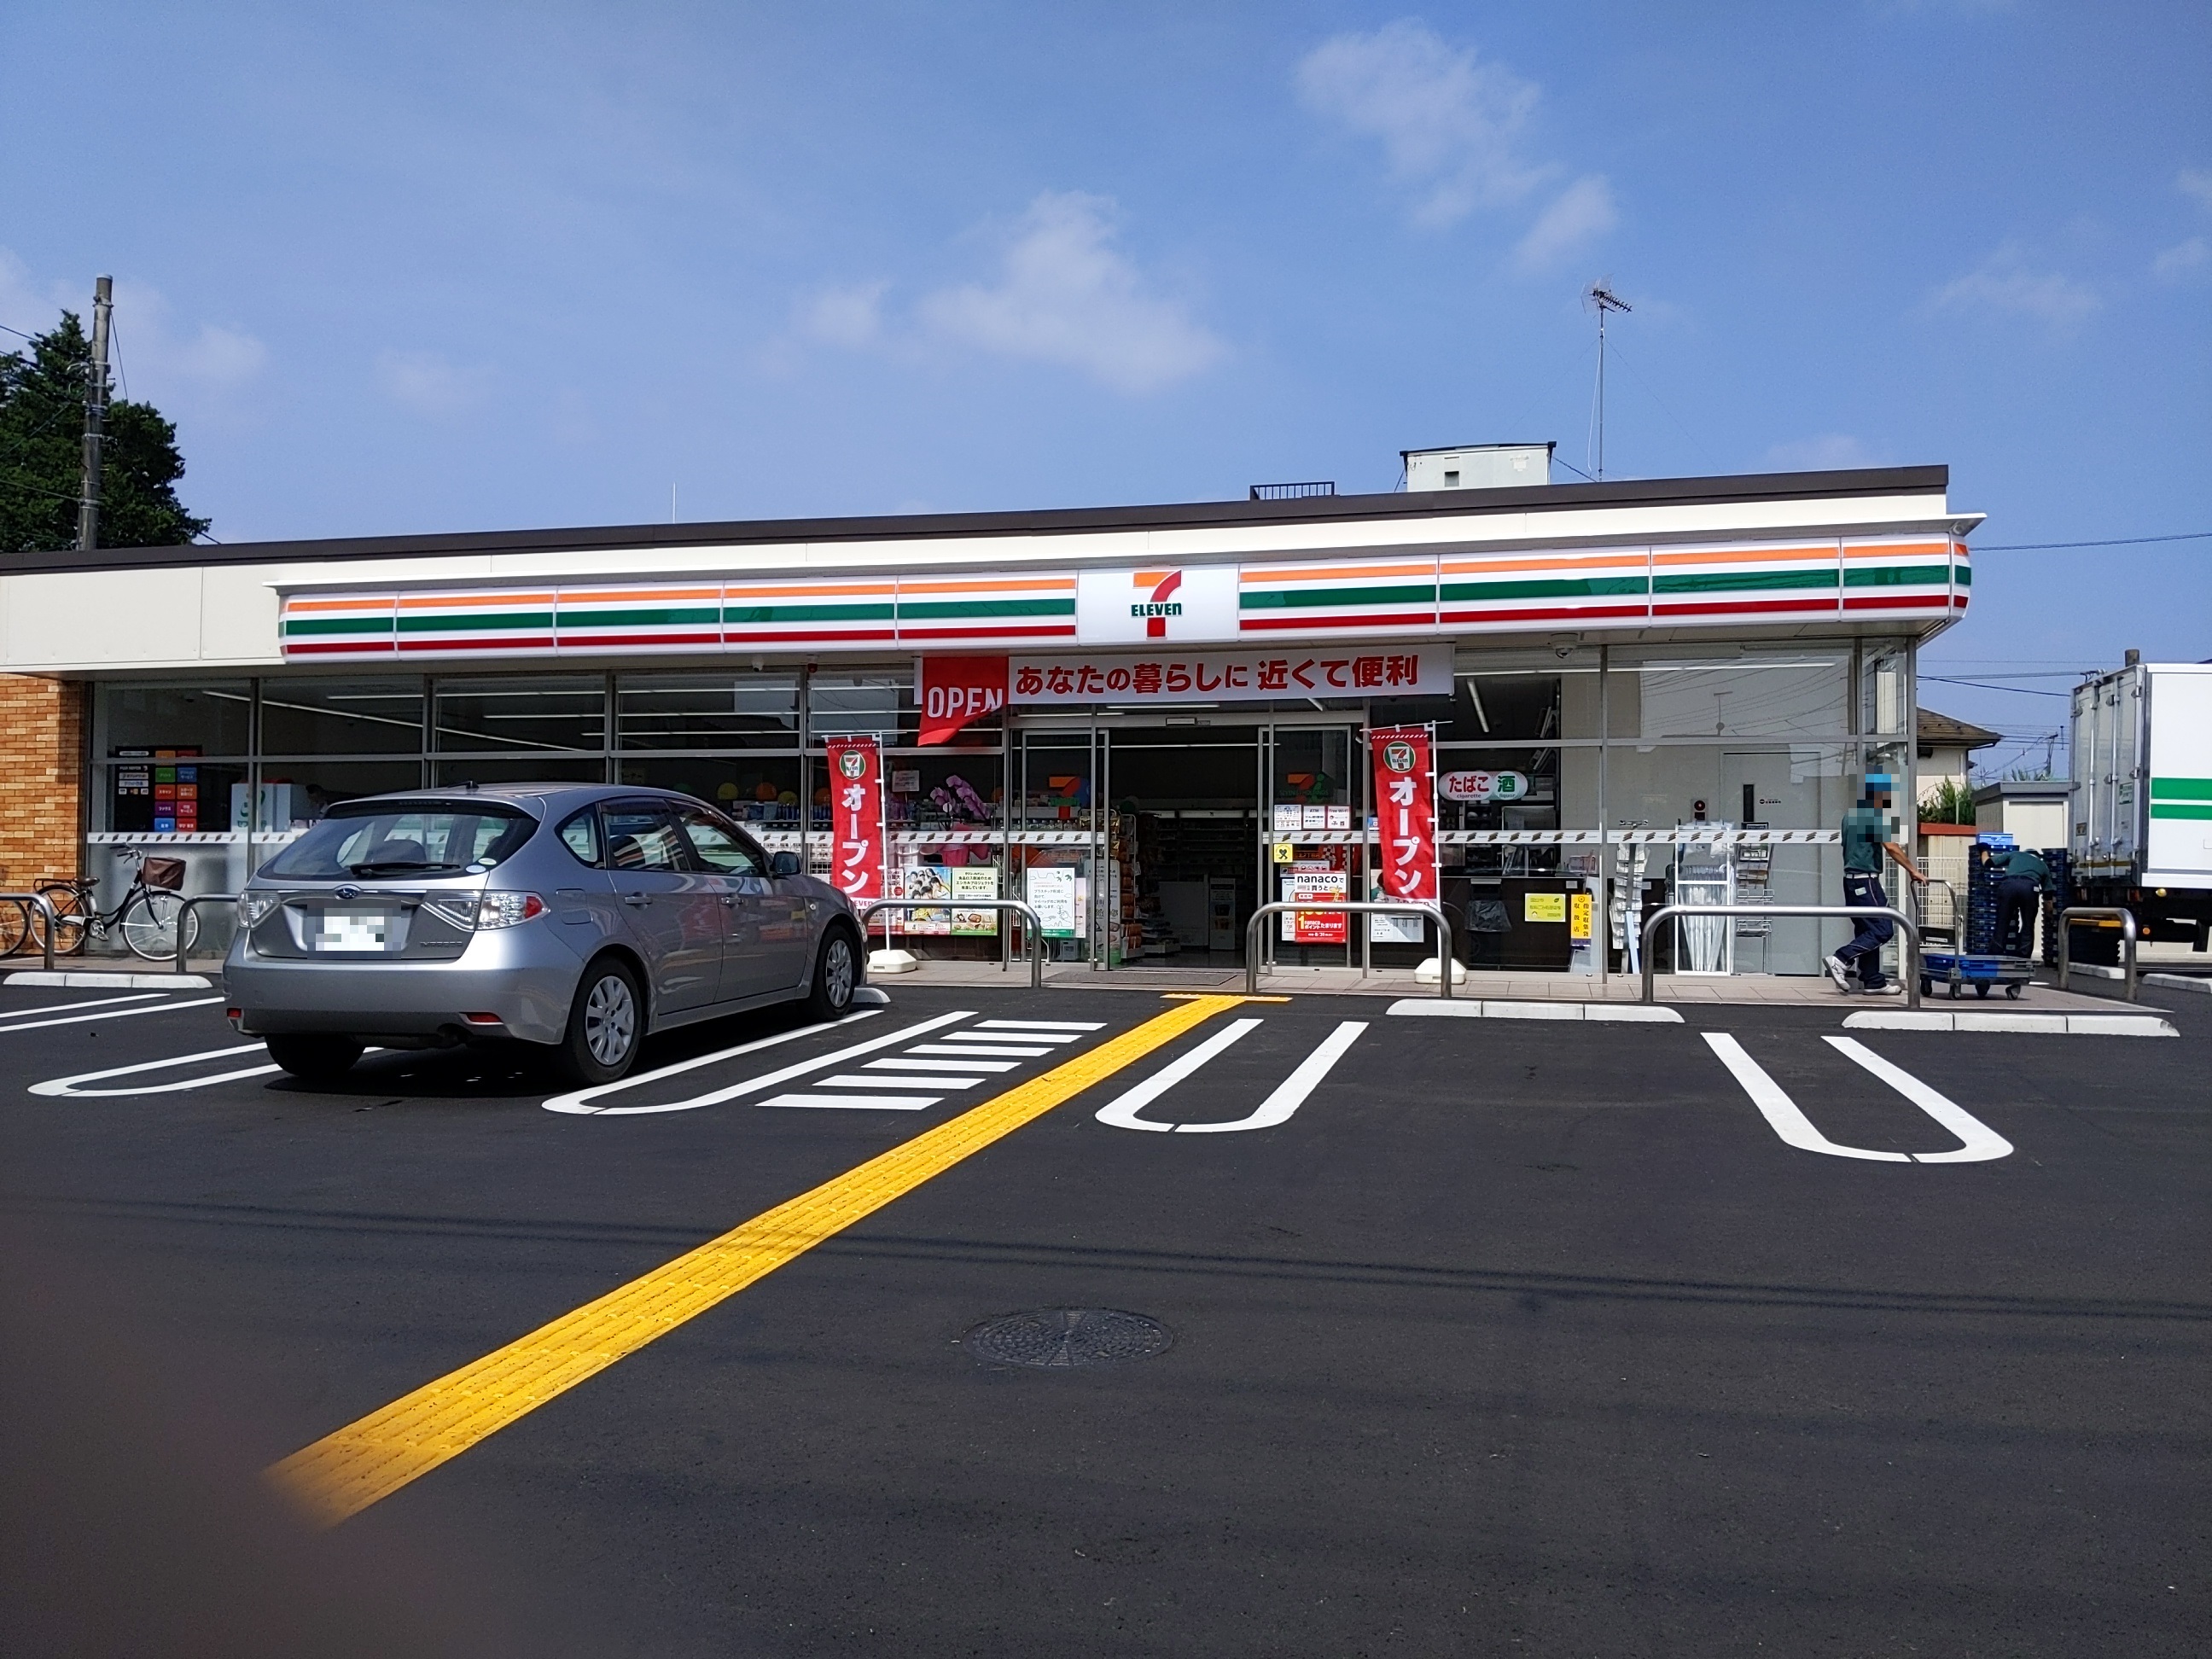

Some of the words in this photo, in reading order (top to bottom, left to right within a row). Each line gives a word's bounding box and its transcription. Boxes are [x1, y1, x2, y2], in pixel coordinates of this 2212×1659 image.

[1016, 663, 1249, 696] あなたの暮らしに
[1257, 655, 1418, 691] 近くて便利
[928, 686, 1003, 719] OPEN
[1449, 775, 1489, 793] たばこ
[1497, 775, 1516, 793] 酒
[841, 783, 869, 894] オープン
[1389, 777, 1422, 894] オープン
